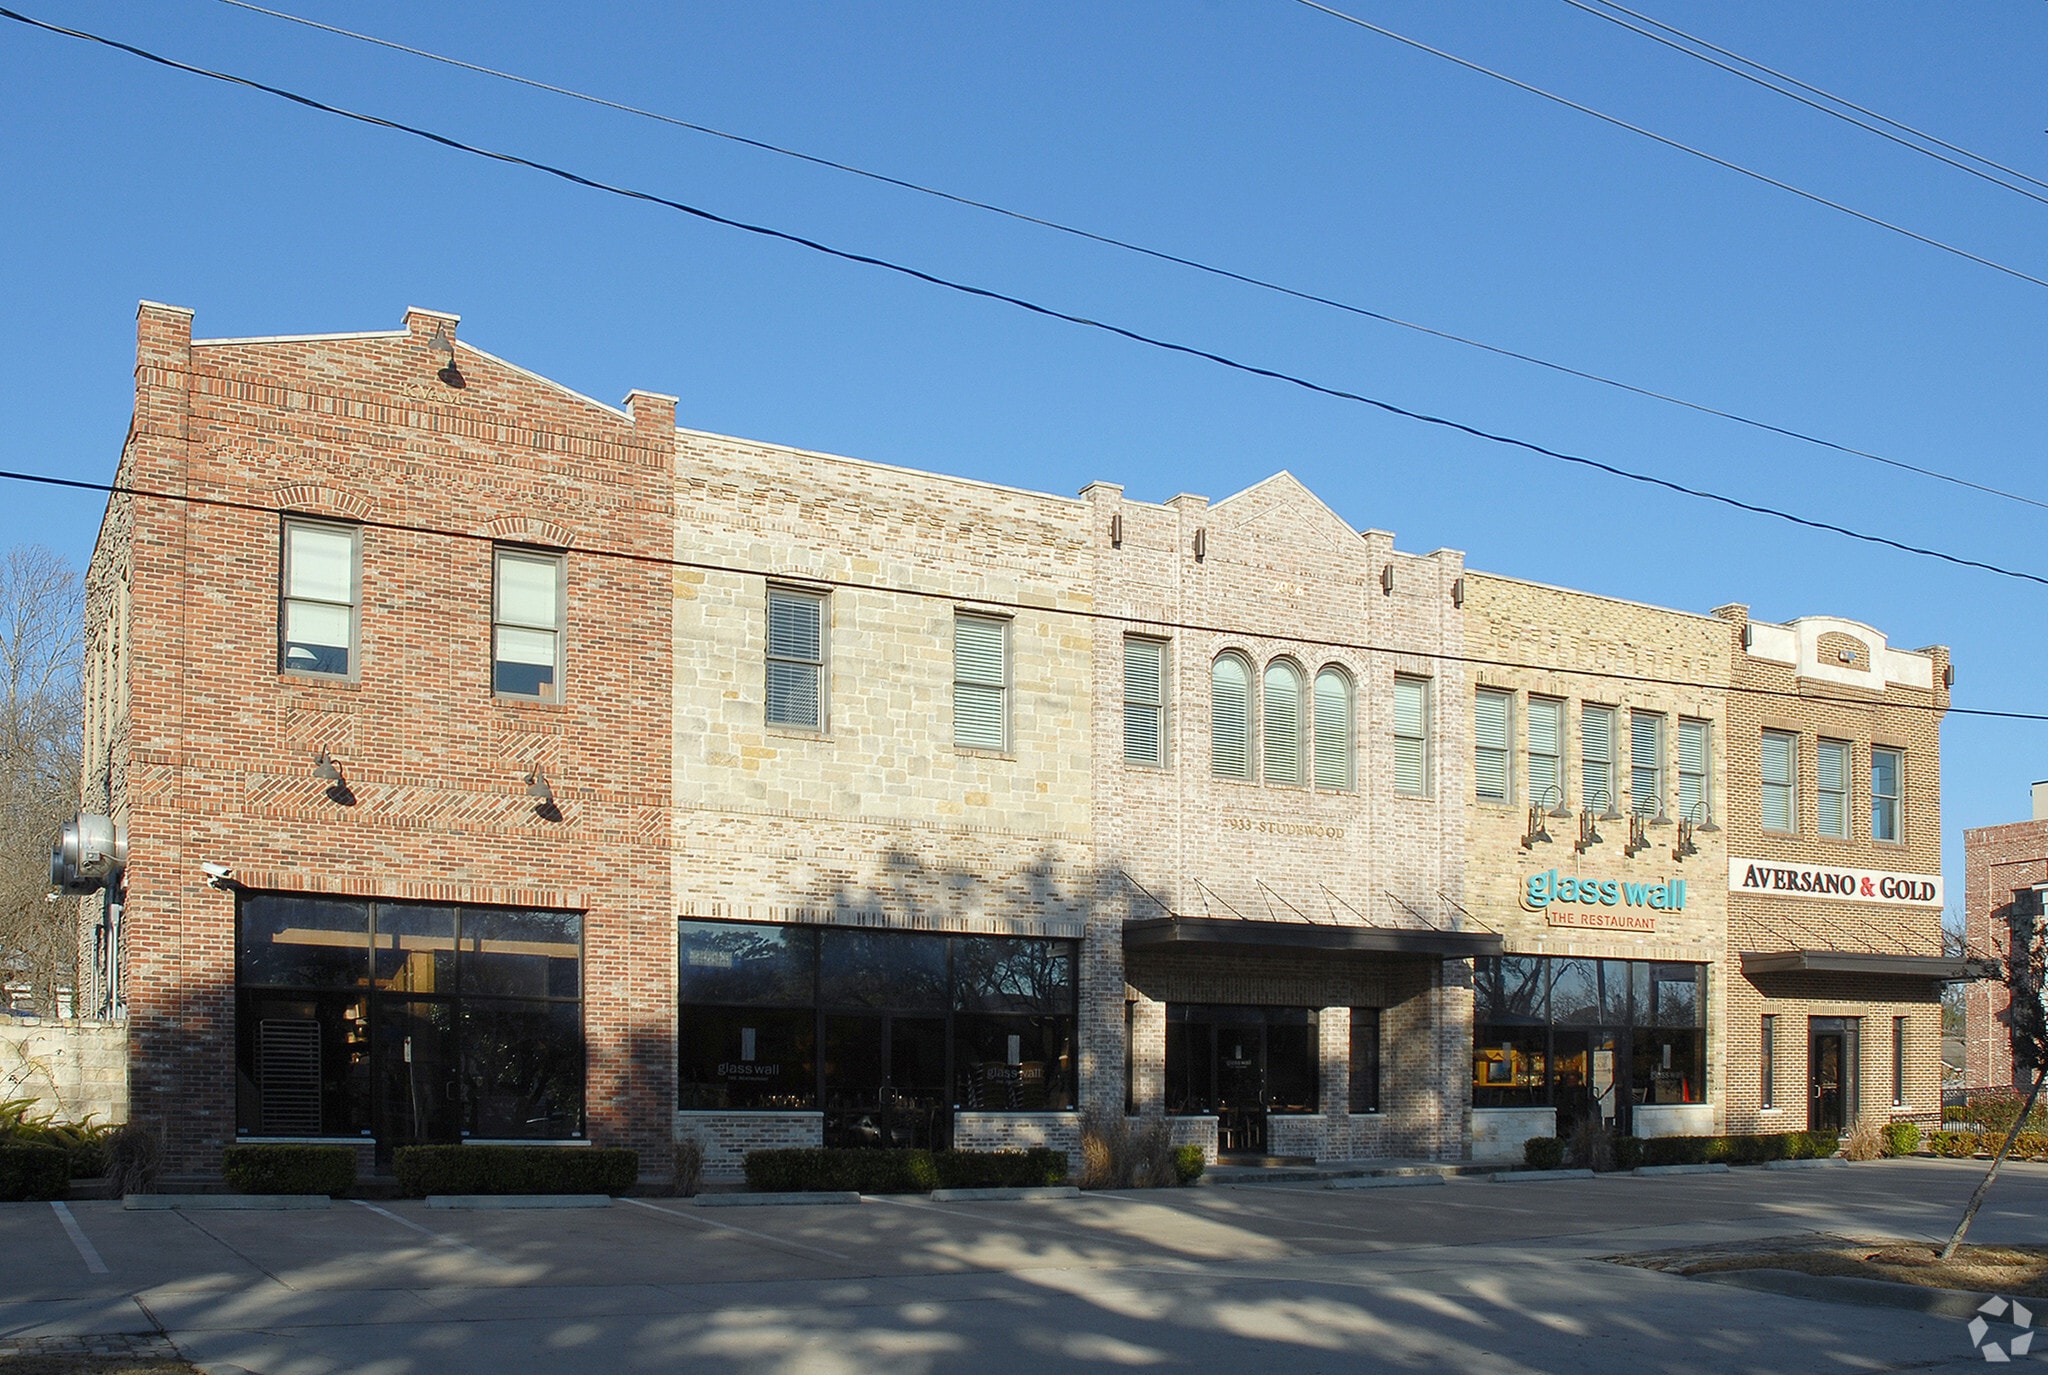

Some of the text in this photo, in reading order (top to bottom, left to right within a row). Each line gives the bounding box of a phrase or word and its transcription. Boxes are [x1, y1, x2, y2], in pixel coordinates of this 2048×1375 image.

[401, 383, 462, 405] KVAM
[1229, 818, 1344, 839] 933 STUDEWOOD
[1527, 867, 1687, 911] glass wall
[1742, 864, 1936, 901] AVERSANO & GOLD
[1551, 912, 1656, 929] THE RESTAURANT
[718, 1062, 779, 1076] glass wall
